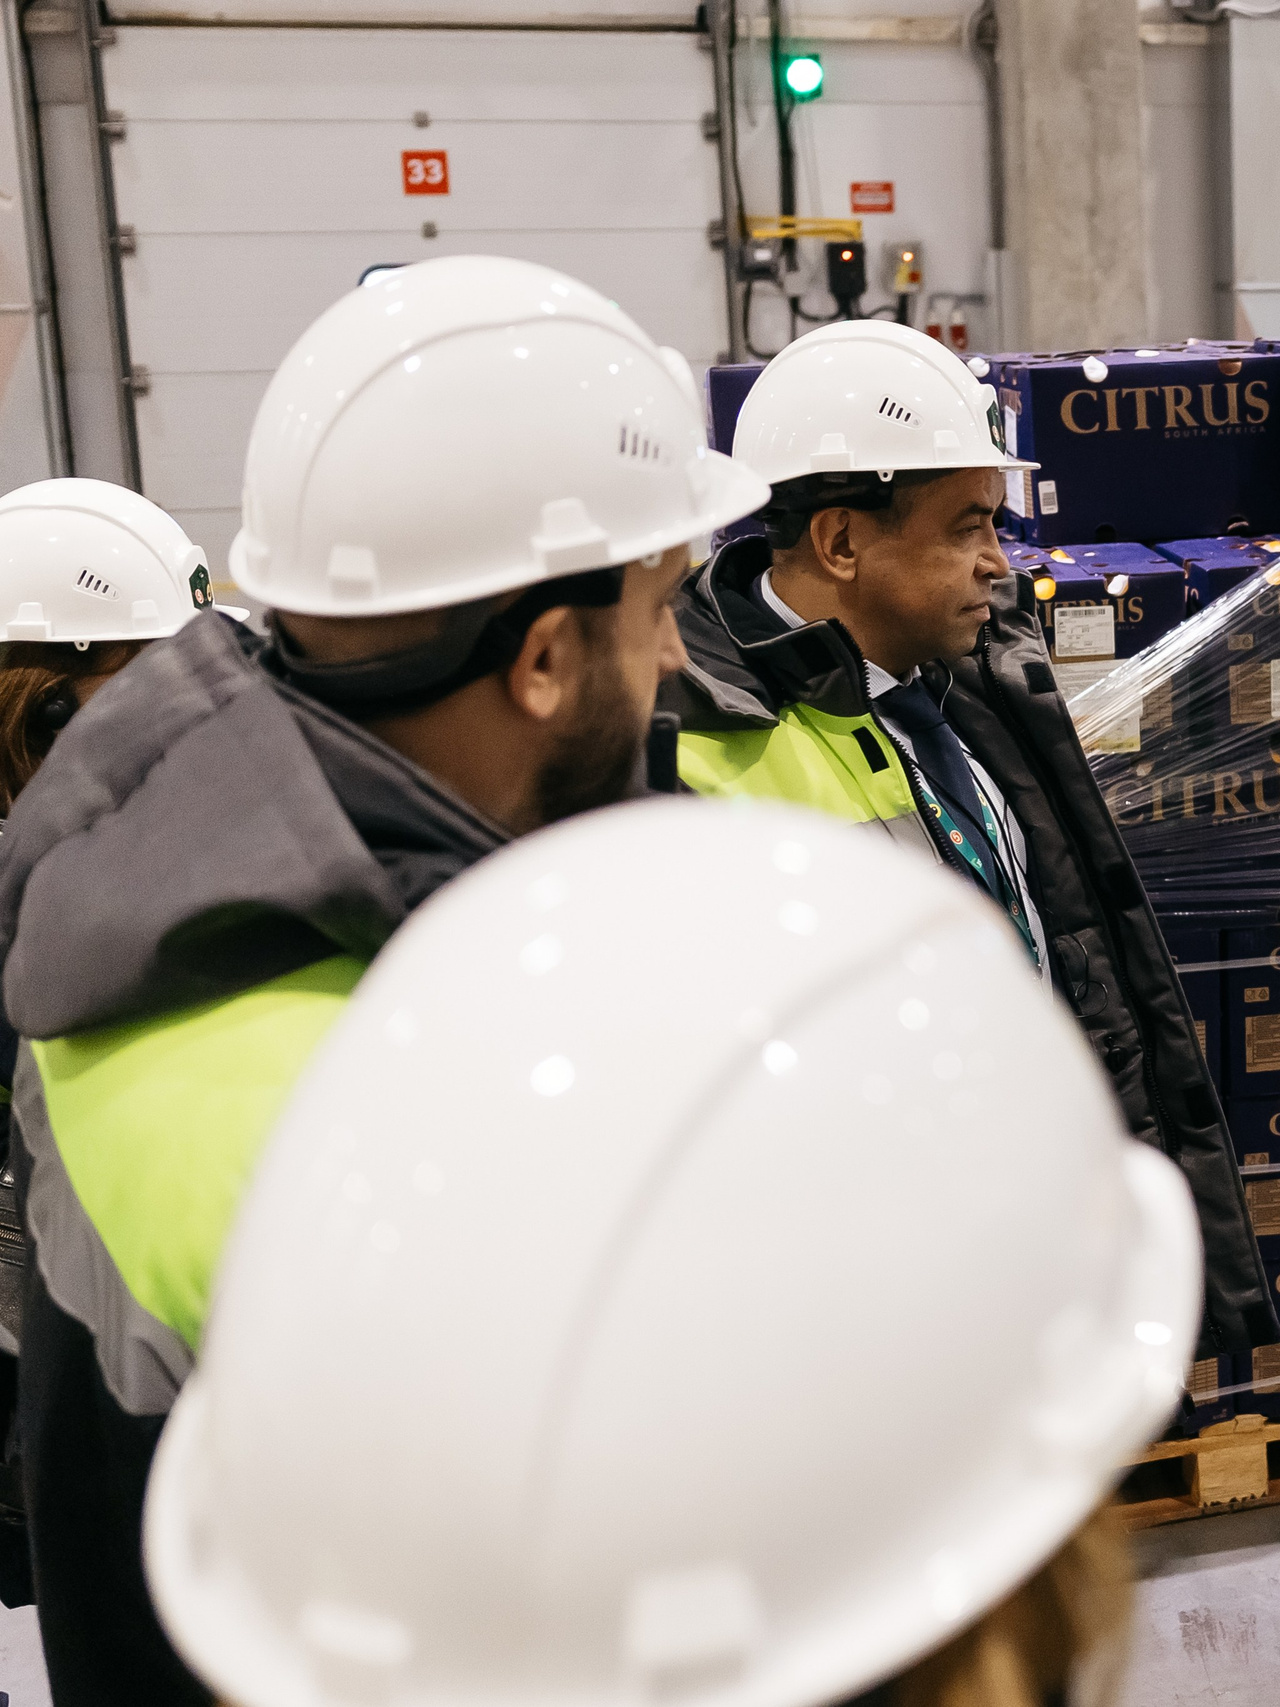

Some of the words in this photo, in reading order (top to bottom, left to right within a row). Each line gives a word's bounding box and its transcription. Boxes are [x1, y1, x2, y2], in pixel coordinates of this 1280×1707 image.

[406, 158, 444, 185] 33
[1060, 380, 1271, 434] CITRUS
[1163, 429, 1210, 439] SOUTH
[1217, 424, 1267, 436] AFRICA
